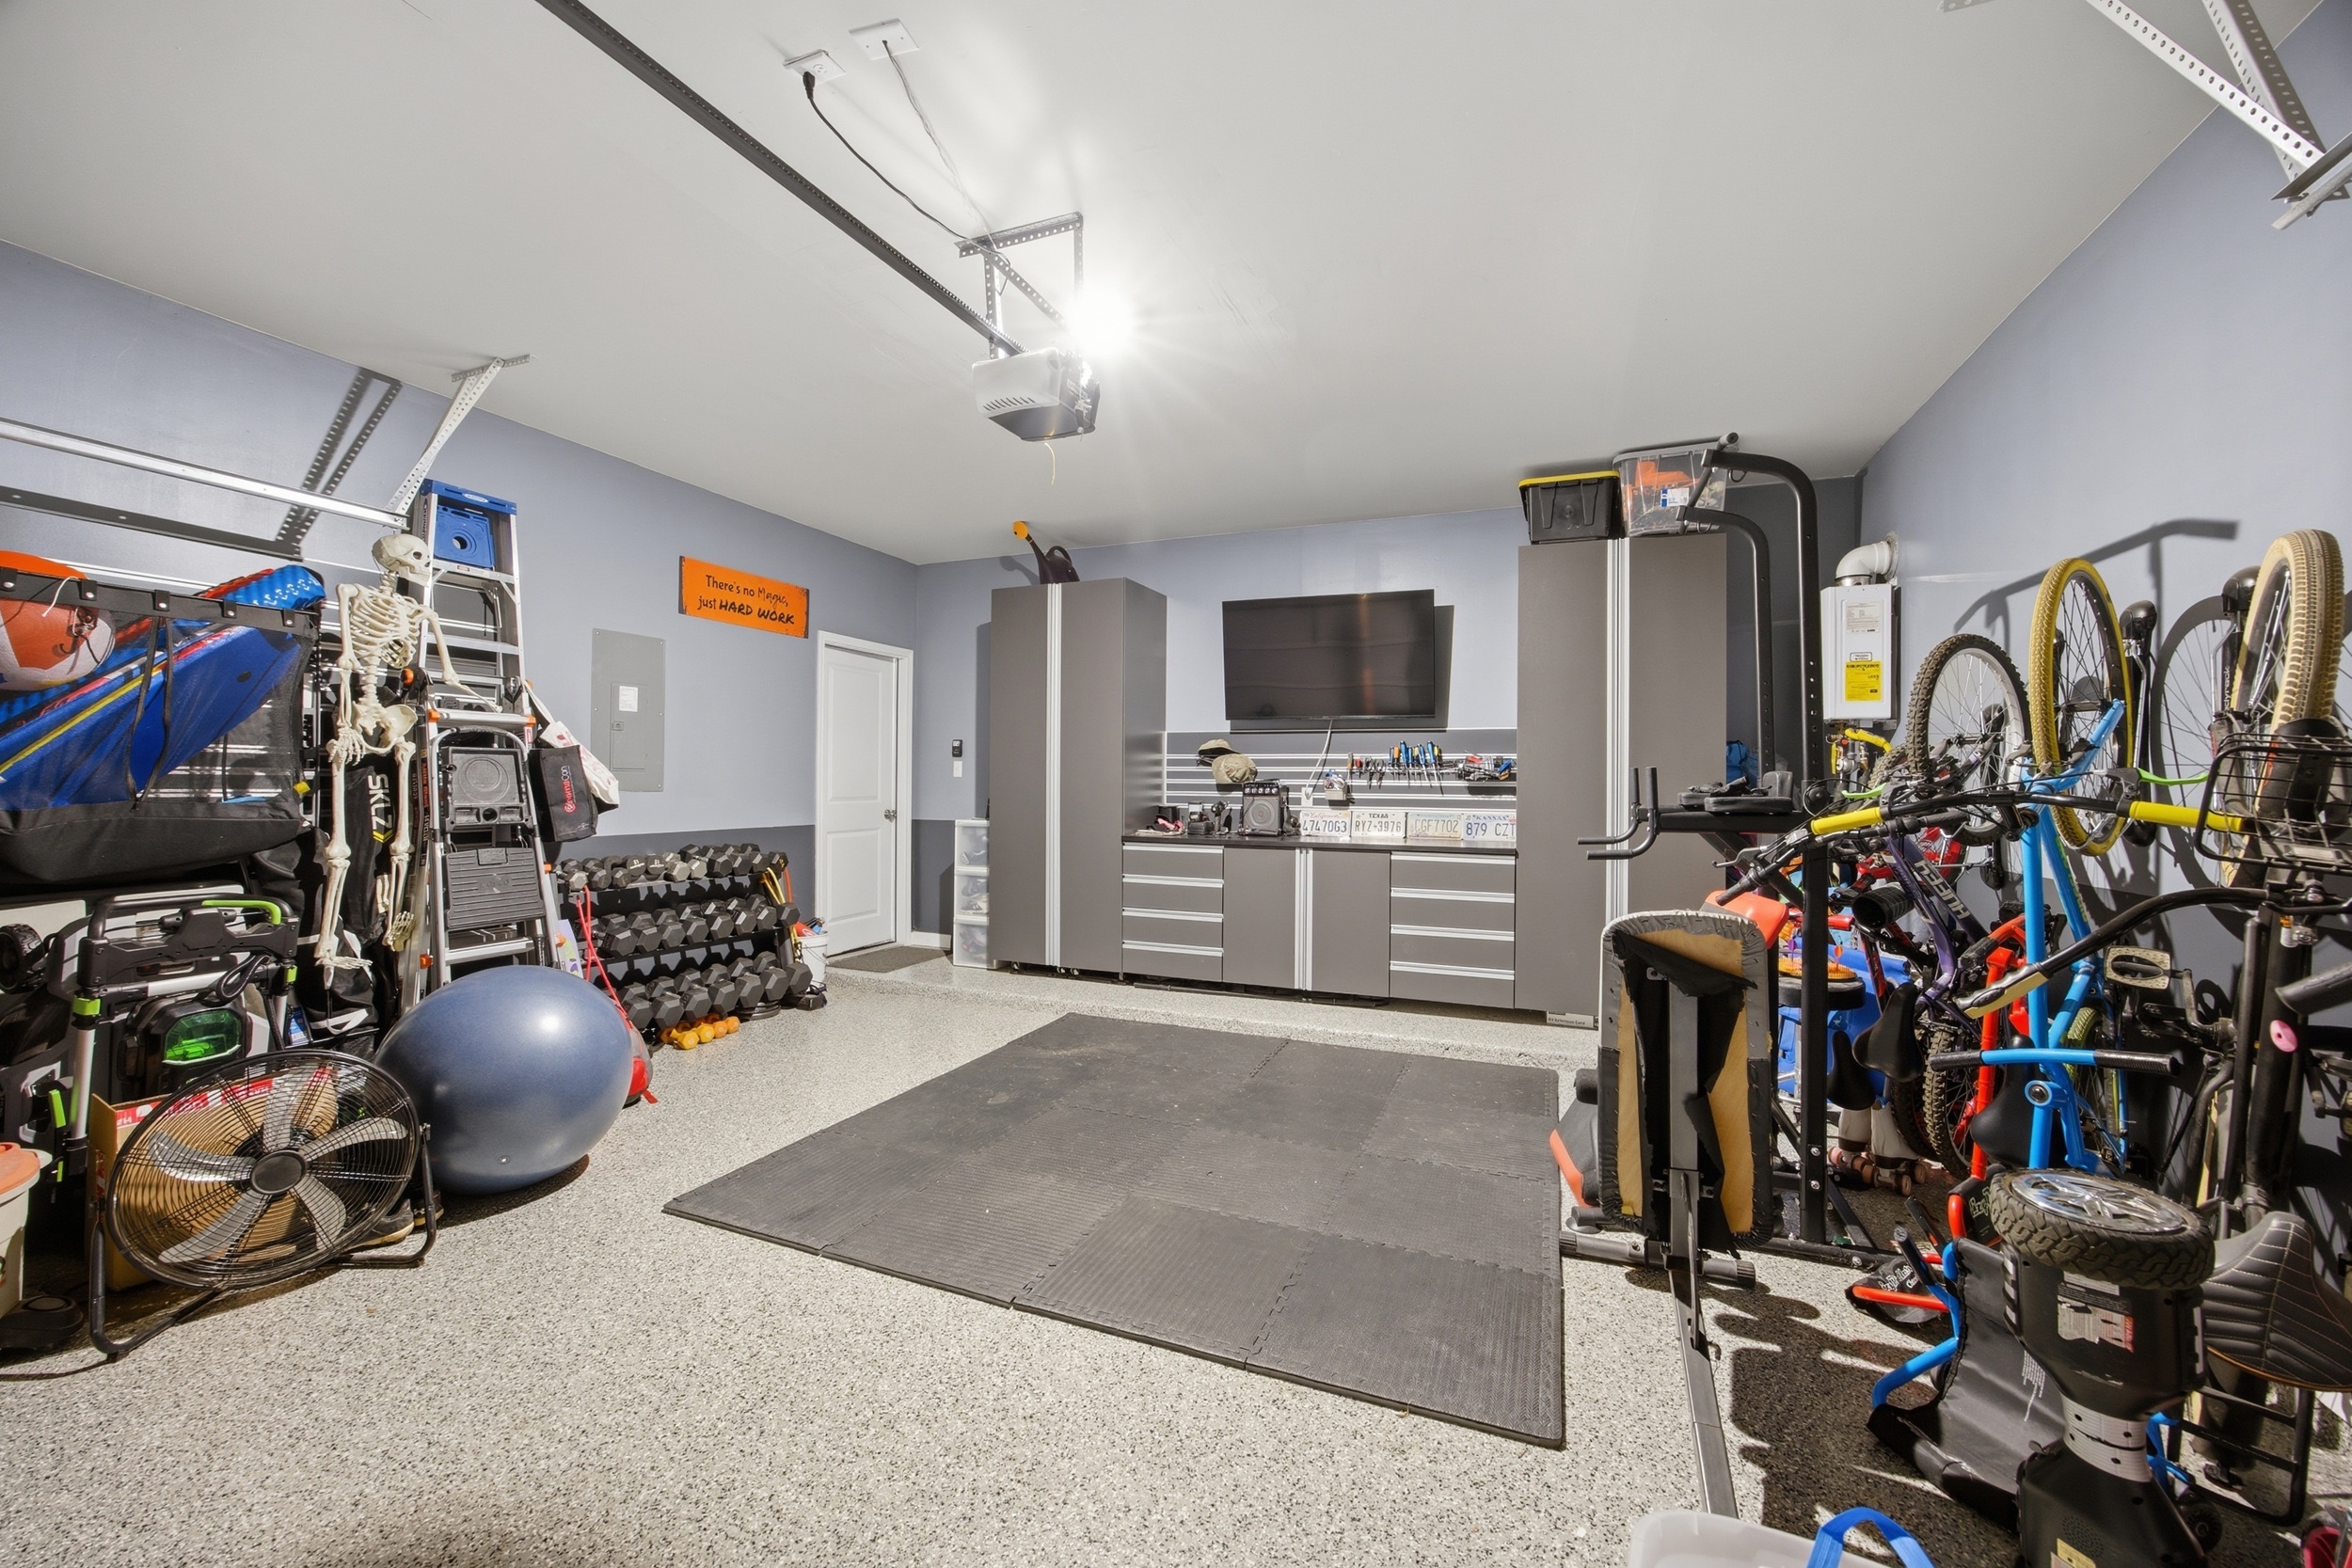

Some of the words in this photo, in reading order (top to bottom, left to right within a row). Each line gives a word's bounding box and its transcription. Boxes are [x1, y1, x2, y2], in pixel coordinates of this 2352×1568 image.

[697, 595, 717, 610] just
[719, 598, 753, 616] HARD
[756, 607, 795, 625] WORK
[705, 574, 740, 594] There's
[742, 587, 755, 597] no
[757, 586, 788, 610] Magic,
[368, 773, 393, 830] SKLZ
[1466, 822, 1487, 836] 879
[1914, 859, 1971, 920] HUFFY
